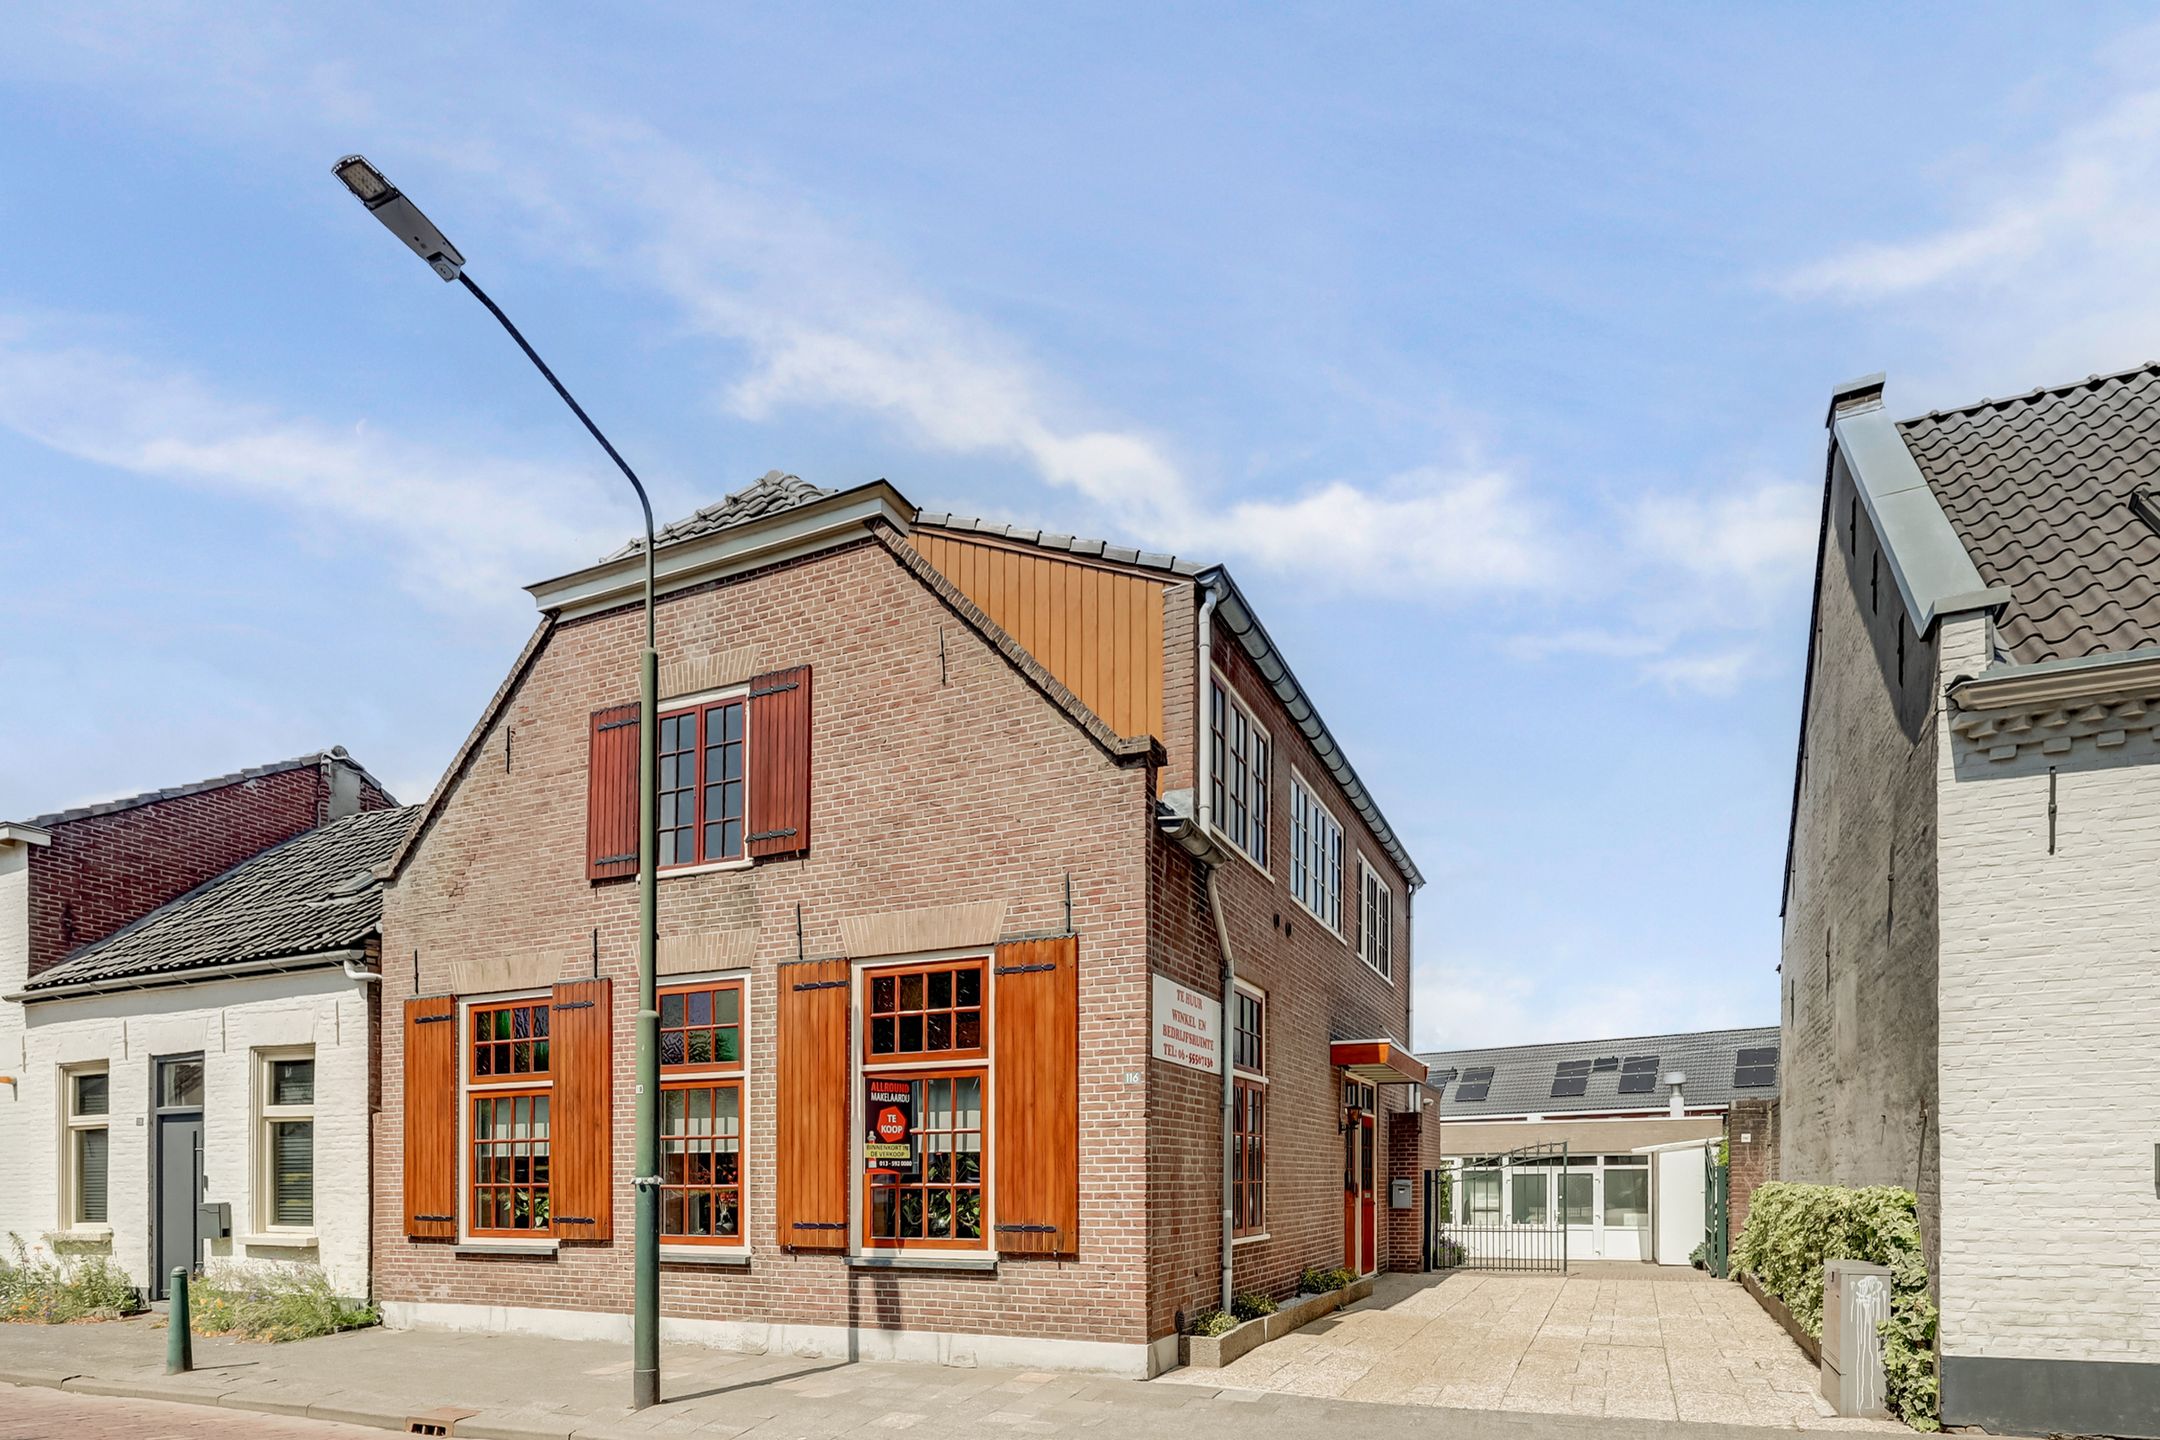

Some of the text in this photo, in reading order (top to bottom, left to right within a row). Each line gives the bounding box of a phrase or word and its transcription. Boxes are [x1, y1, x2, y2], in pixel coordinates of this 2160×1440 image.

[1177, 989, 1203, 1010] TE HUUR
[1172, 1008, 1207, 1032] WINKEL EN
[1162, 1024, 1214, 1051] BEDRIJFSRUIMTE
[1126, 1072, 1139, 1084] 116
[871, 1081, 910, 1093] ALLROUND
[887, 1114, 897, 1123] TE
[881, 1125, 903, 1134] KOOP
